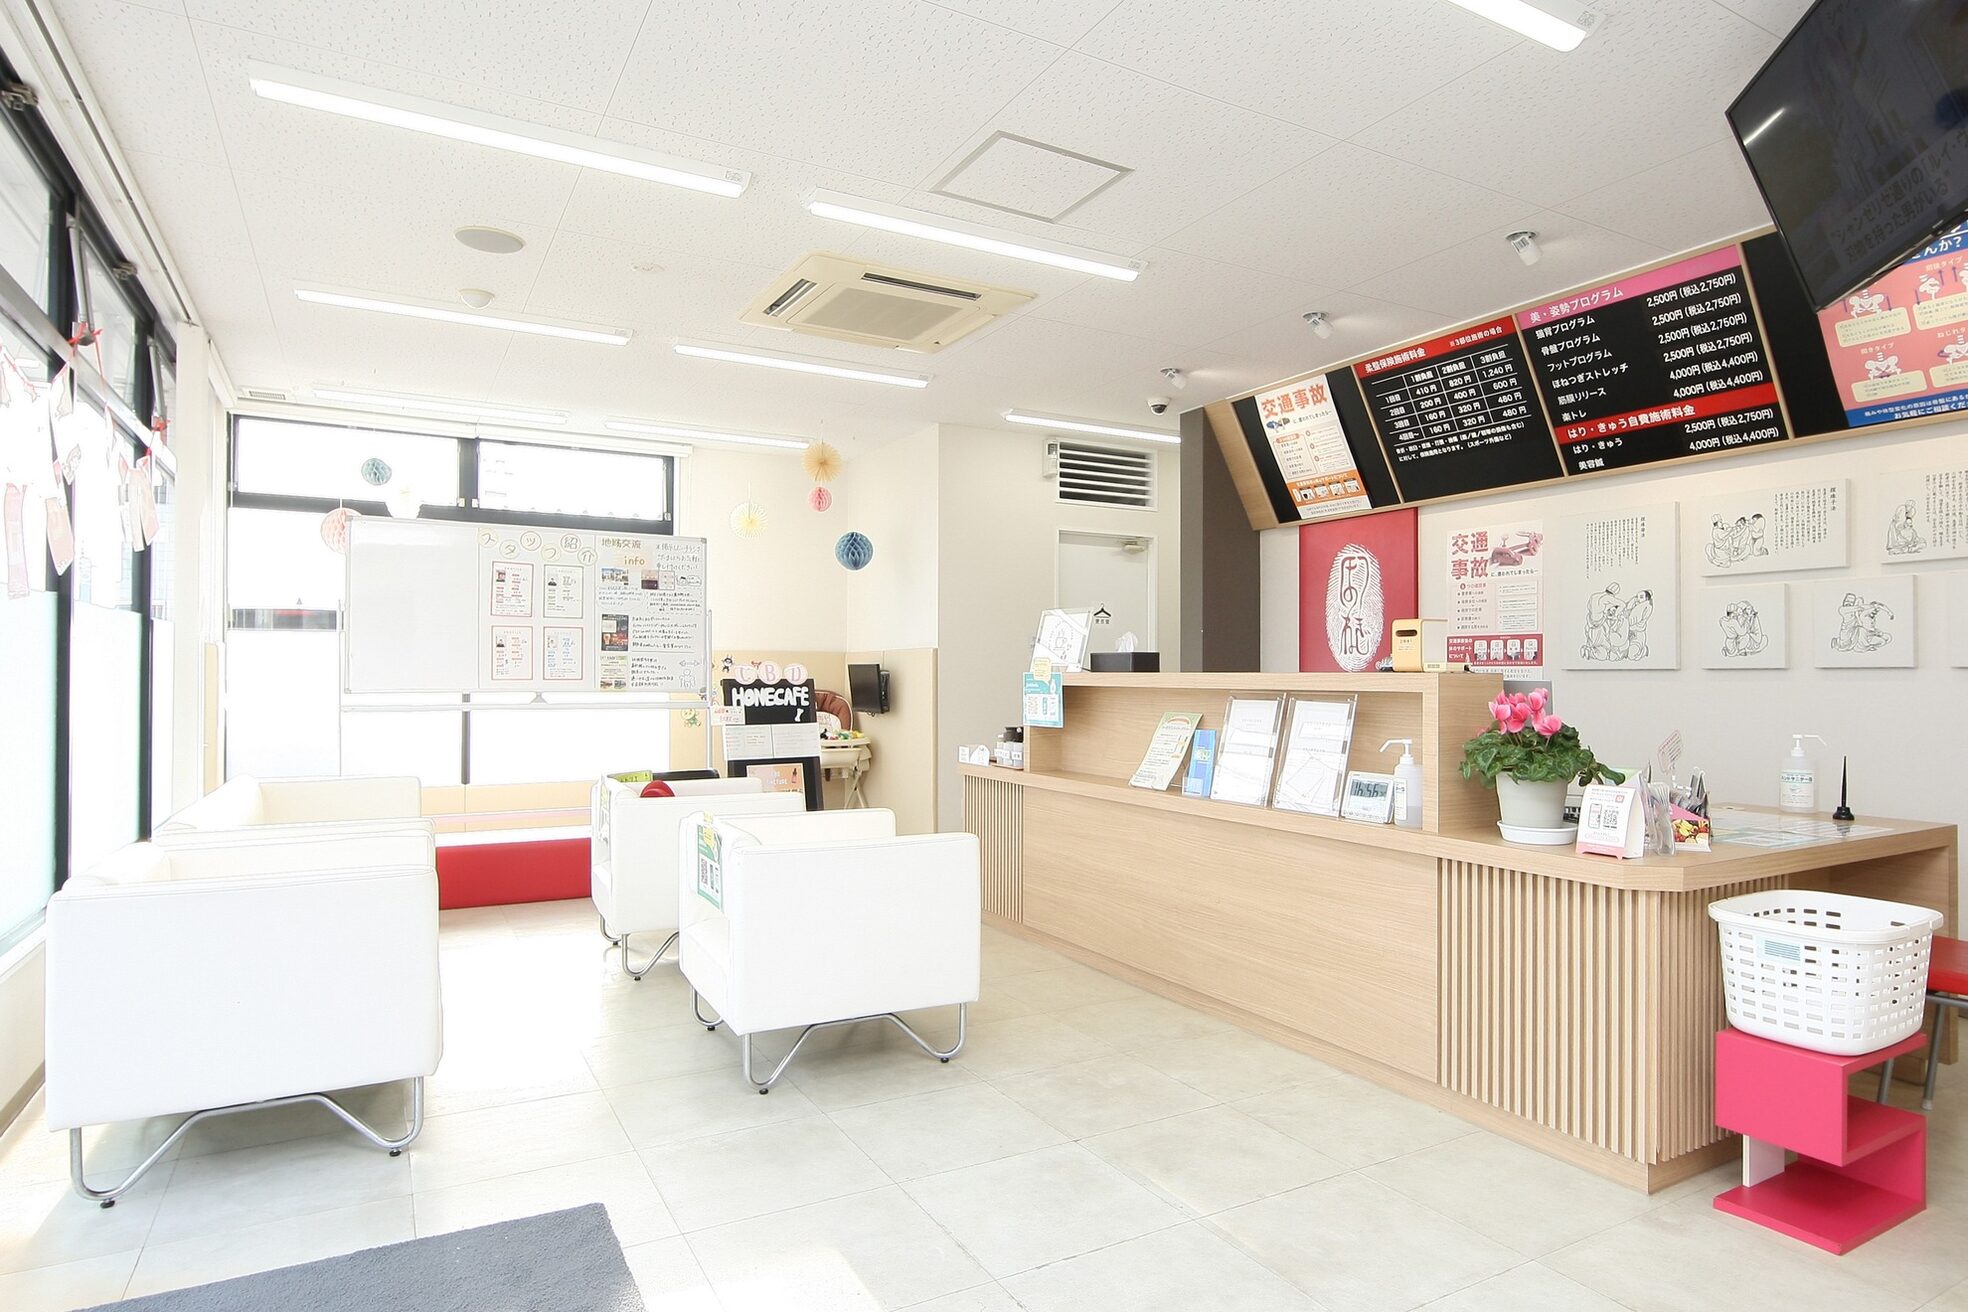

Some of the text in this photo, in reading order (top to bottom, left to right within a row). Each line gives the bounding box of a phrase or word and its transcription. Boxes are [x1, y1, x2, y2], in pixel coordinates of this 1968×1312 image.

[1911, 237, 1962, 259] んか?
[1529, 287, 1624, 323] 美・姿勢プログラム
[1535, 315, 1596, 340] 猫背プログラム
[1541, 334, 1601, 356] 骨盤プログラム
[1547, 349, 1613, 372] フットプログラム
[1552, 363, 1629, 389] ほねつぎストレッチ
[1261, 384, 1328, 419] 交通事故
[1557, 387, 1607, 406] 筋膜リリース
[1562, 410, 1587, 422] 楽トレ
[1567, 405, 1696, 439] はり・きゅう自費施術料金
[1572, 438, 1623, 454] はり・きゅう
[1451, 531, 1489, 556] 交通
[624, 556, 645, 566] info
[1451, 557, 1489, 580] 事故
[732, 687, 810, 707] HONECAFE
